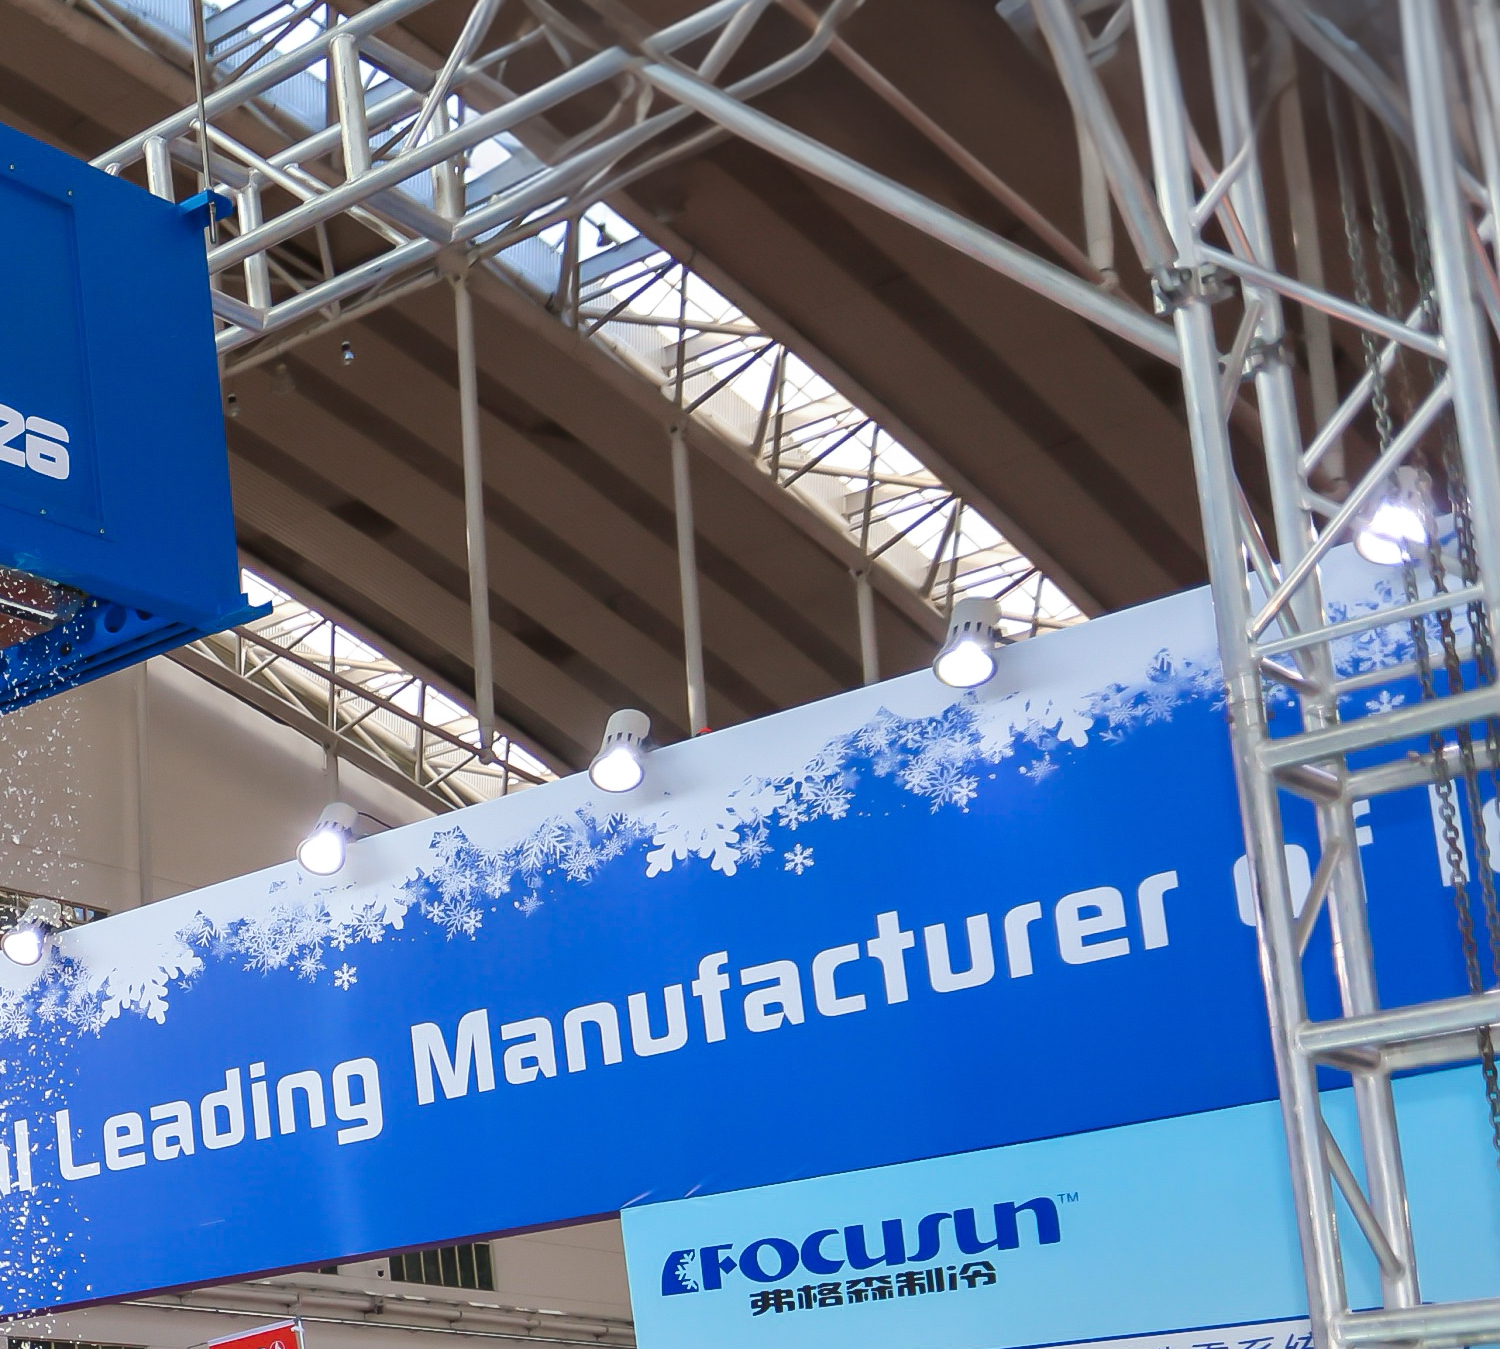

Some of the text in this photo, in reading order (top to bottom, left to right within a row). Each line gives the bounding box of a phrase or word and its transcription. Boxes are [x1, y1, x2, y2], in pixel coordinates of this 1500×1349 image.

[56, 1057, 383, 1181] Leading
[411, 870, 1179, 1105] Manufacturer
[750, 1261, 998, 1317] 弗格森制冷
